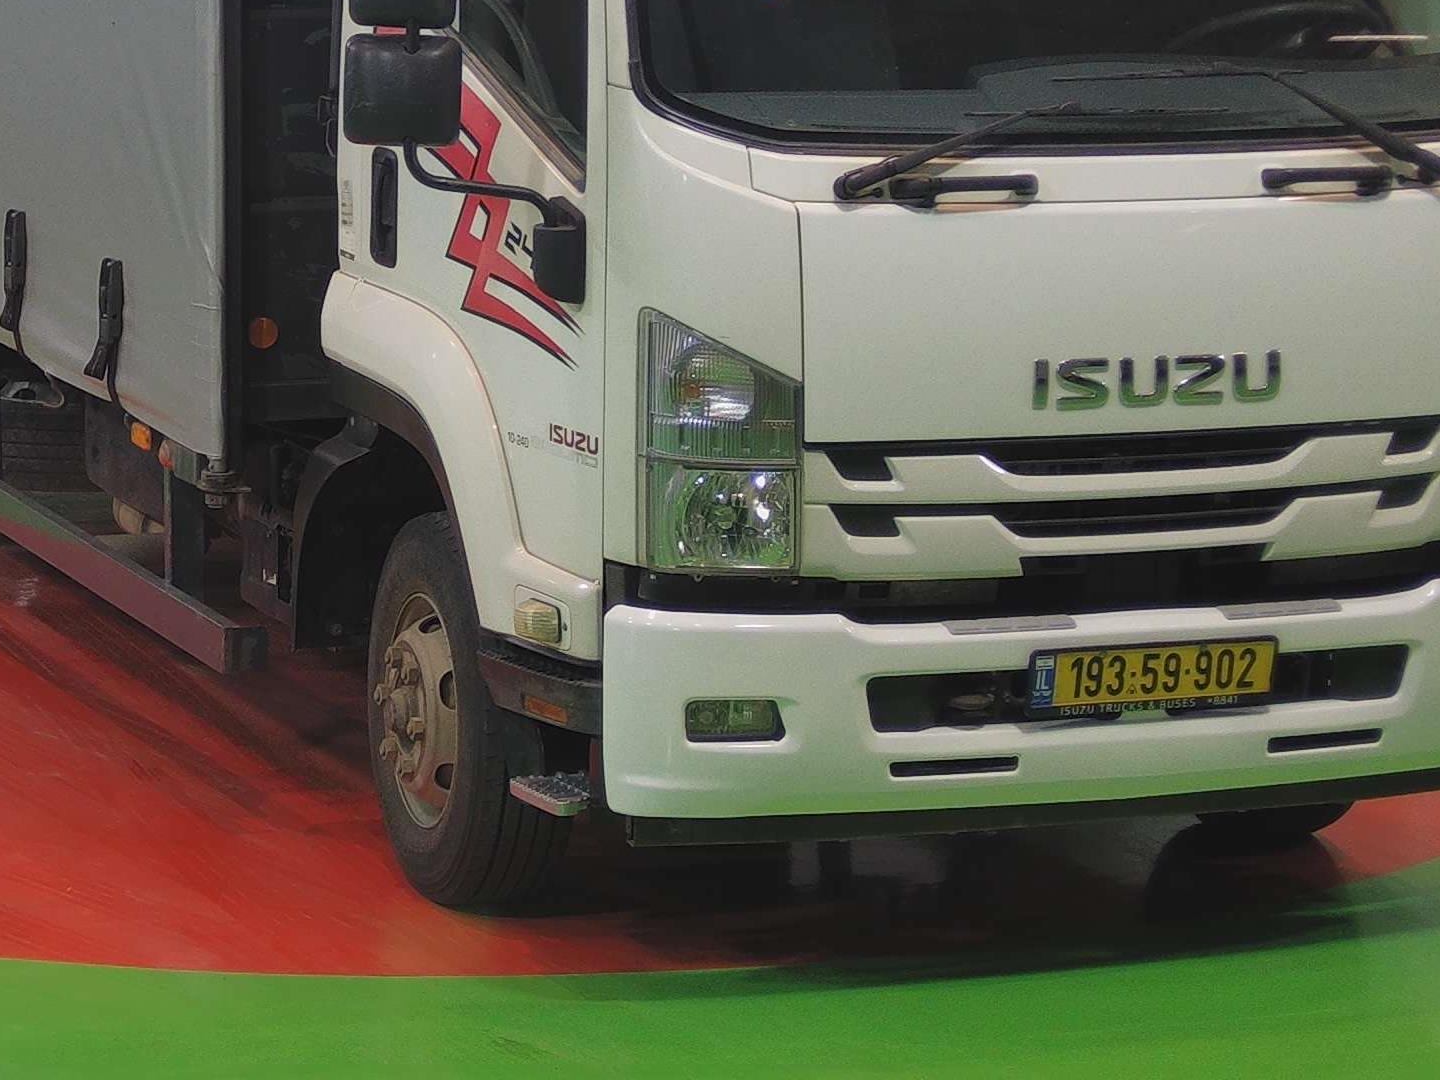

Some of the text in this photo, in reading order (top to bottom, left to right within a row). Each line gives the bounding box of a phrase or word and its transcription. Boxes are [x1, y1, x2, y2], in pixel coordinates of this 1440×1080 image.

[1032, 349, 1281, 411] ISUZU
[549, 423, 599, 455] ISUZU
[1060, 702, 1094, 716] ISUZU
[1100, 703, 1144, 713] TRUCKS
[1160, 698, 1197, 709] BUSES
